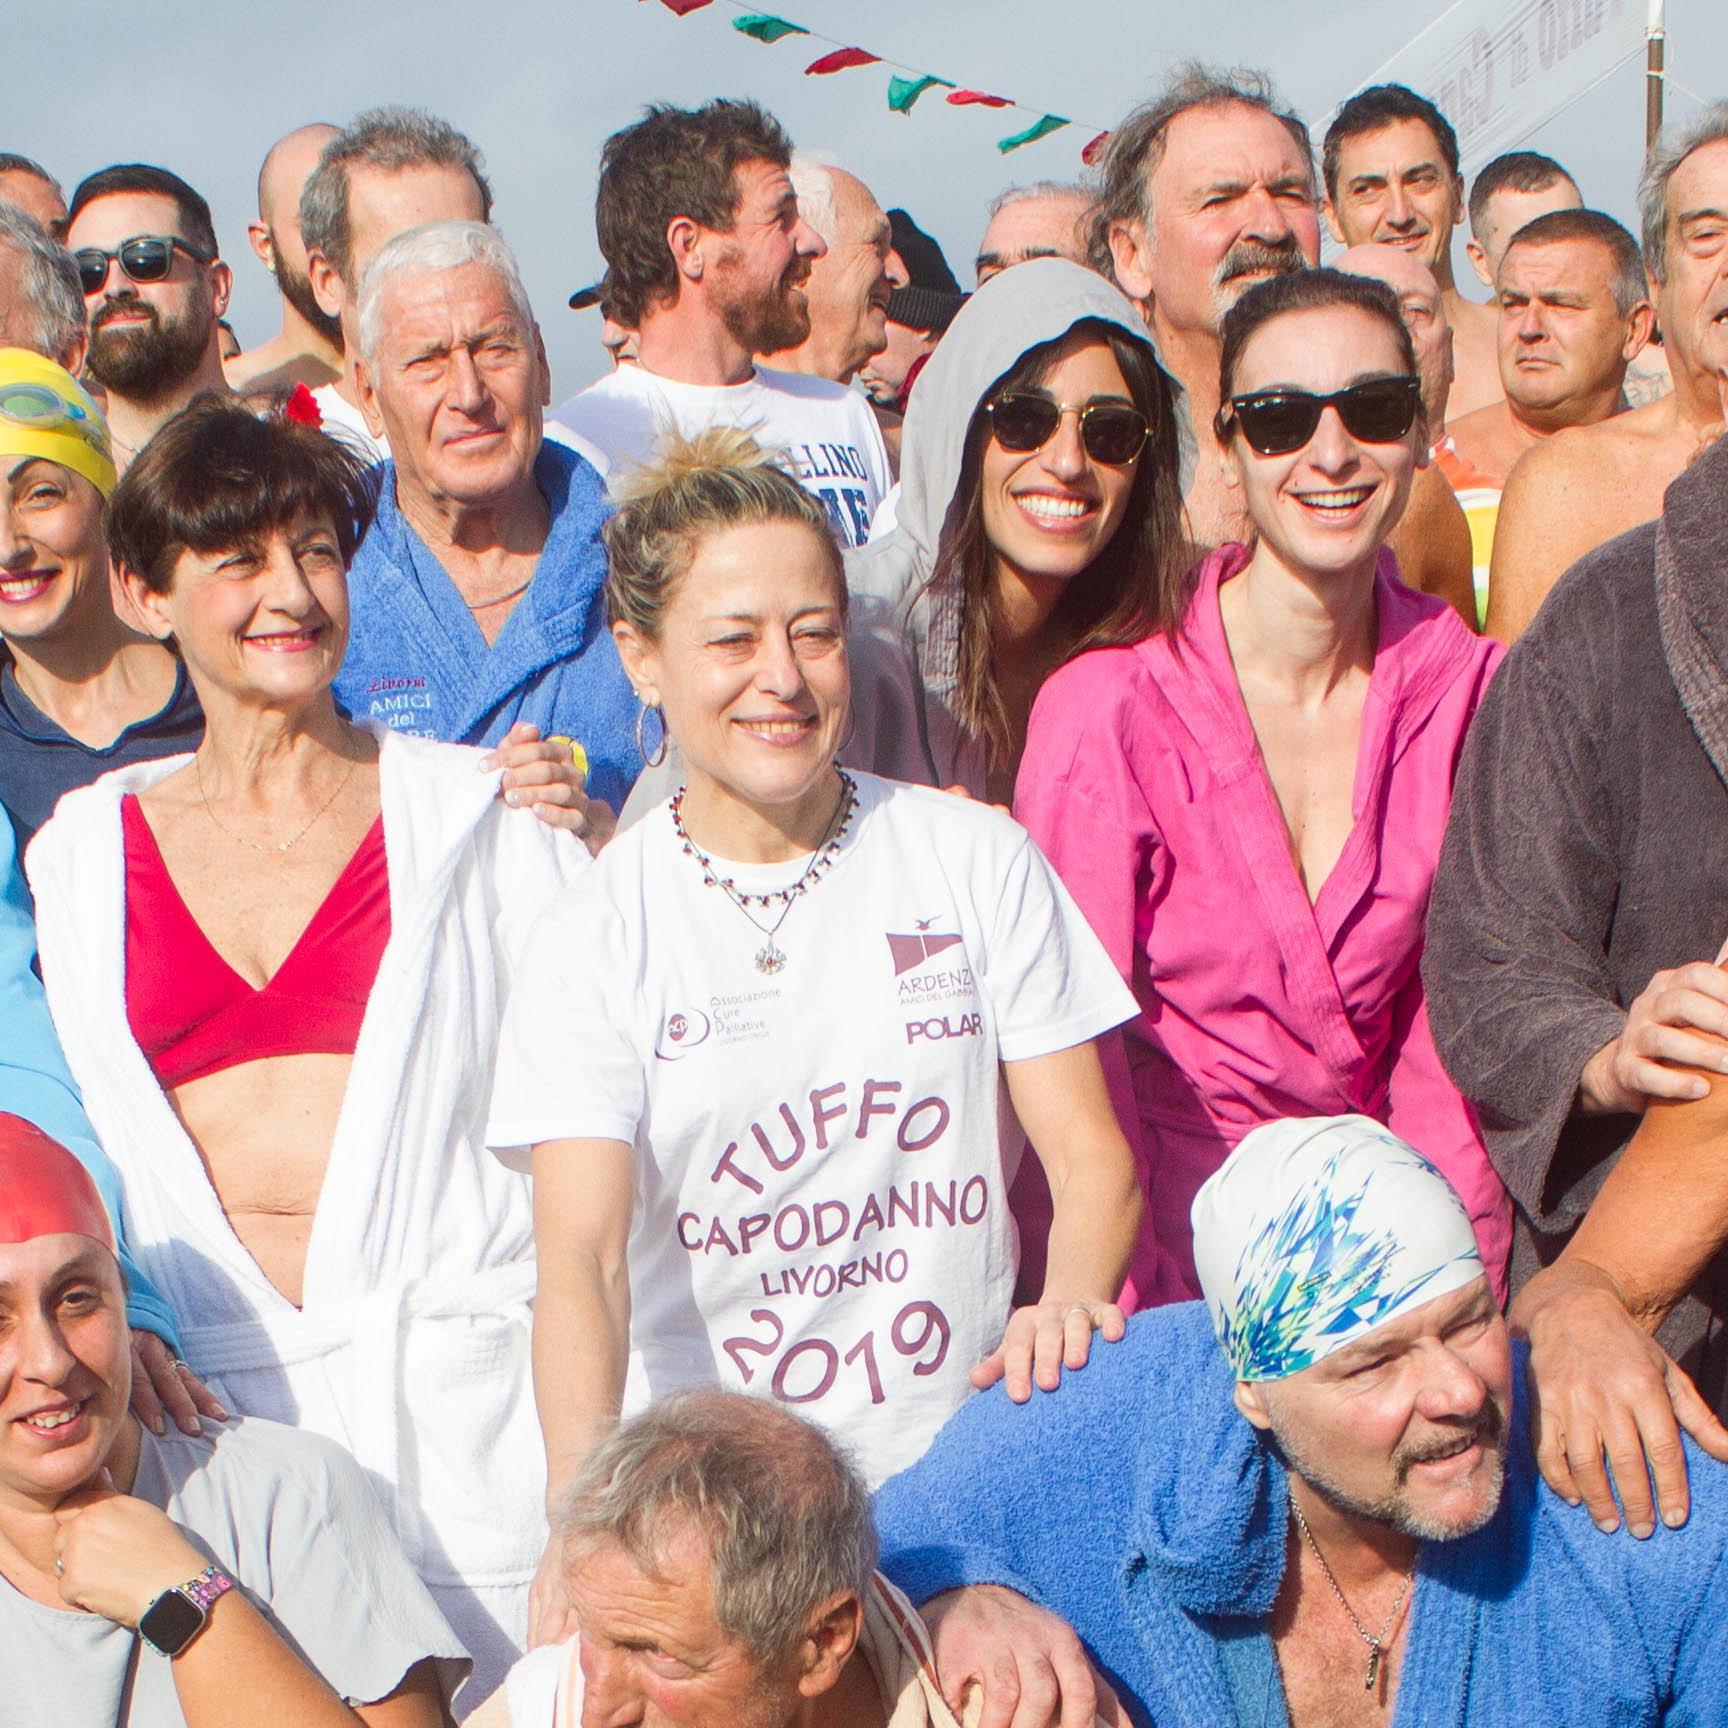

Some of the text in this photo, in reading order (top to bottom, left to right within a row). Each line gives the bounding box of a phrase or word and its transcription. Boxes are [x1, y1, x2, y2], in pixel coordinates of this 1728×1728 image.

[370, 693, 432, 716] AMICI
[387, 711, 415, 728] del
[713, 1007, 741, 1020] Cure
[715, 1019, 767, 1037] Palliative
[905, 1012, 983, 1045] POLAR
[711, 1079, 950, 1195] TUFFO
[677, 1174, 988, 1256] CAPODANNO
[760, 1248, 909, 1298] LIVORNO
[722, 1300, 951, 1405] 2019
